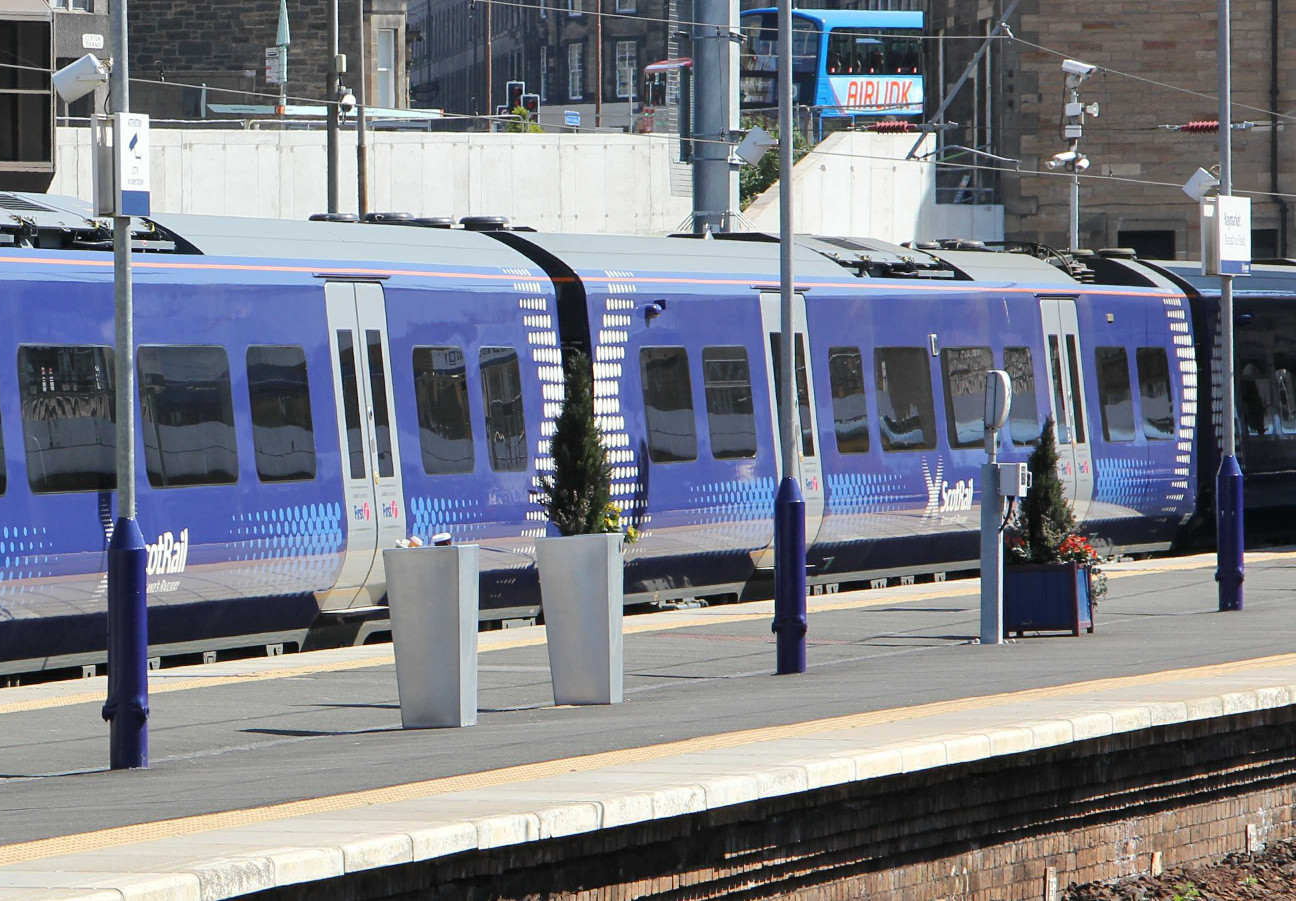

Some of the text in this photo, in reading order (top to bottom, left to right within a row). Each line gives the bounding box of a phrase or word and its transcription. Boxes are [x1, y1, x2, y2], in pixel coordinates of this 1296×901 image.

[846, 80, 912, 109] AIRLINK
[940, 478, 974, 512] ScotRail
[145, 527, 189, 576] otRail
